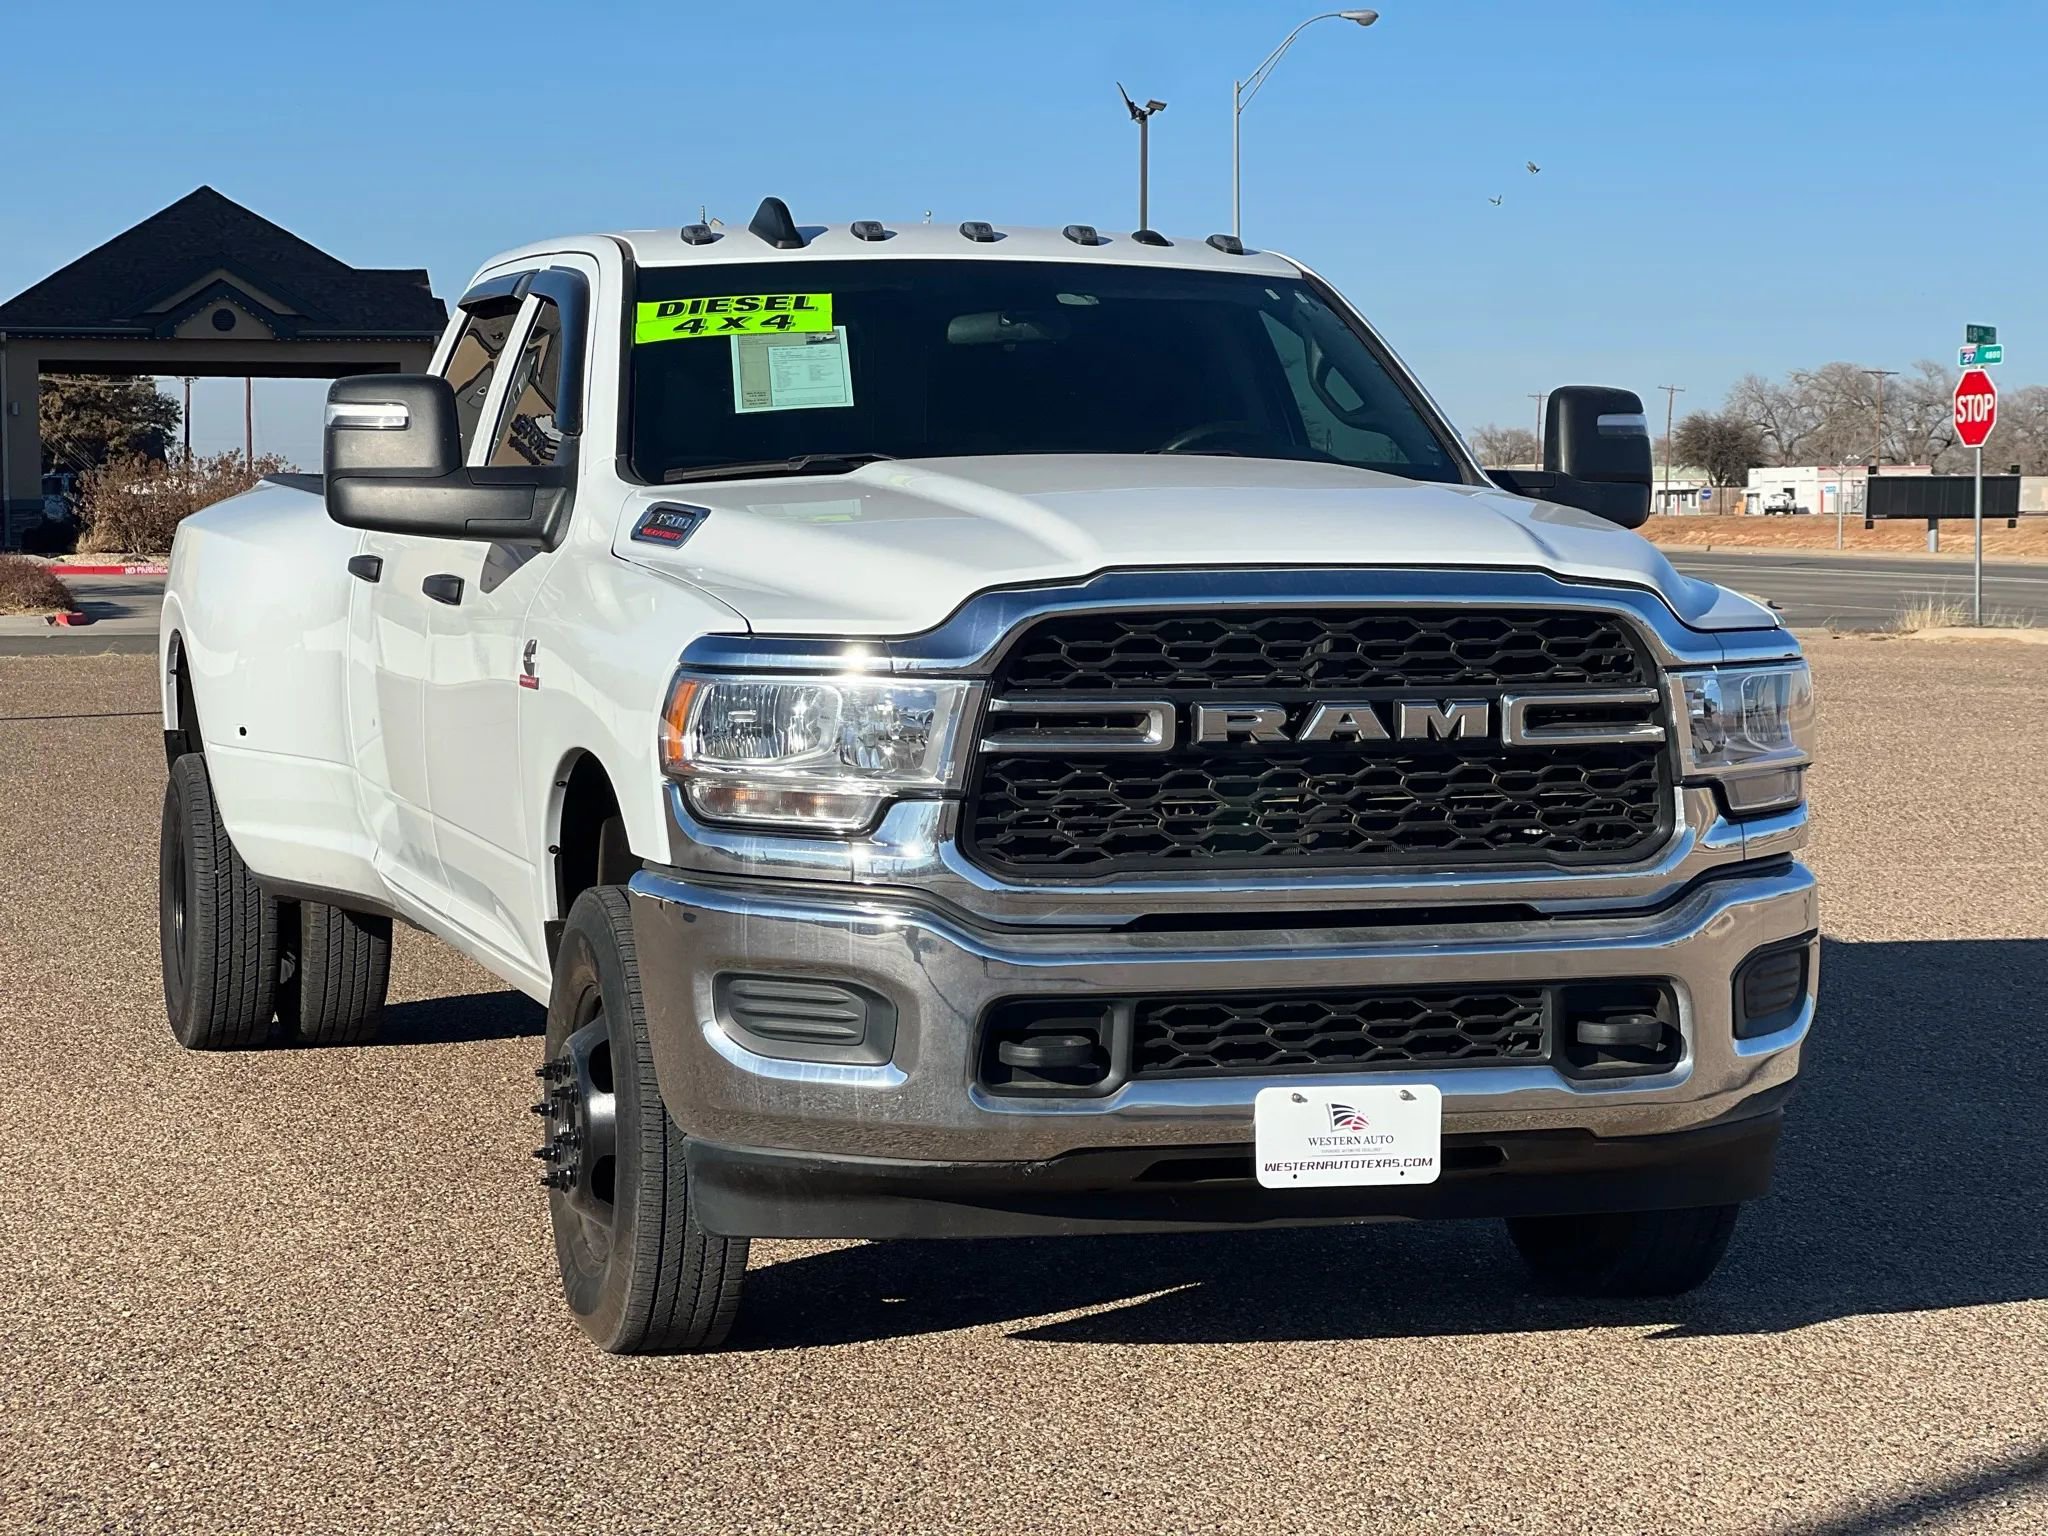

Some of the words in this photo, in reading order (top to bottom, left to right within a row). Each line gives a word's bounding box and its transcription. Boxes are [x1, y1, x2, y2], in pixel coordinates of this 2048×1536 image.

[656, 295, 818, 318] DIESEL
[1963, 353, 1975, 363] 27
[1957, 393, 1994, 424] STOP
[125, 566, 136, 575] NO
[1190, 698, 1489, 744] RAM
[1308, 1136, 1361, 1147] WESTERN
[1363, 1135, 1394, 1145] AUTO
[1264, 1158, 1433, 1172] WESTERNAUTOTEXAS.COM
